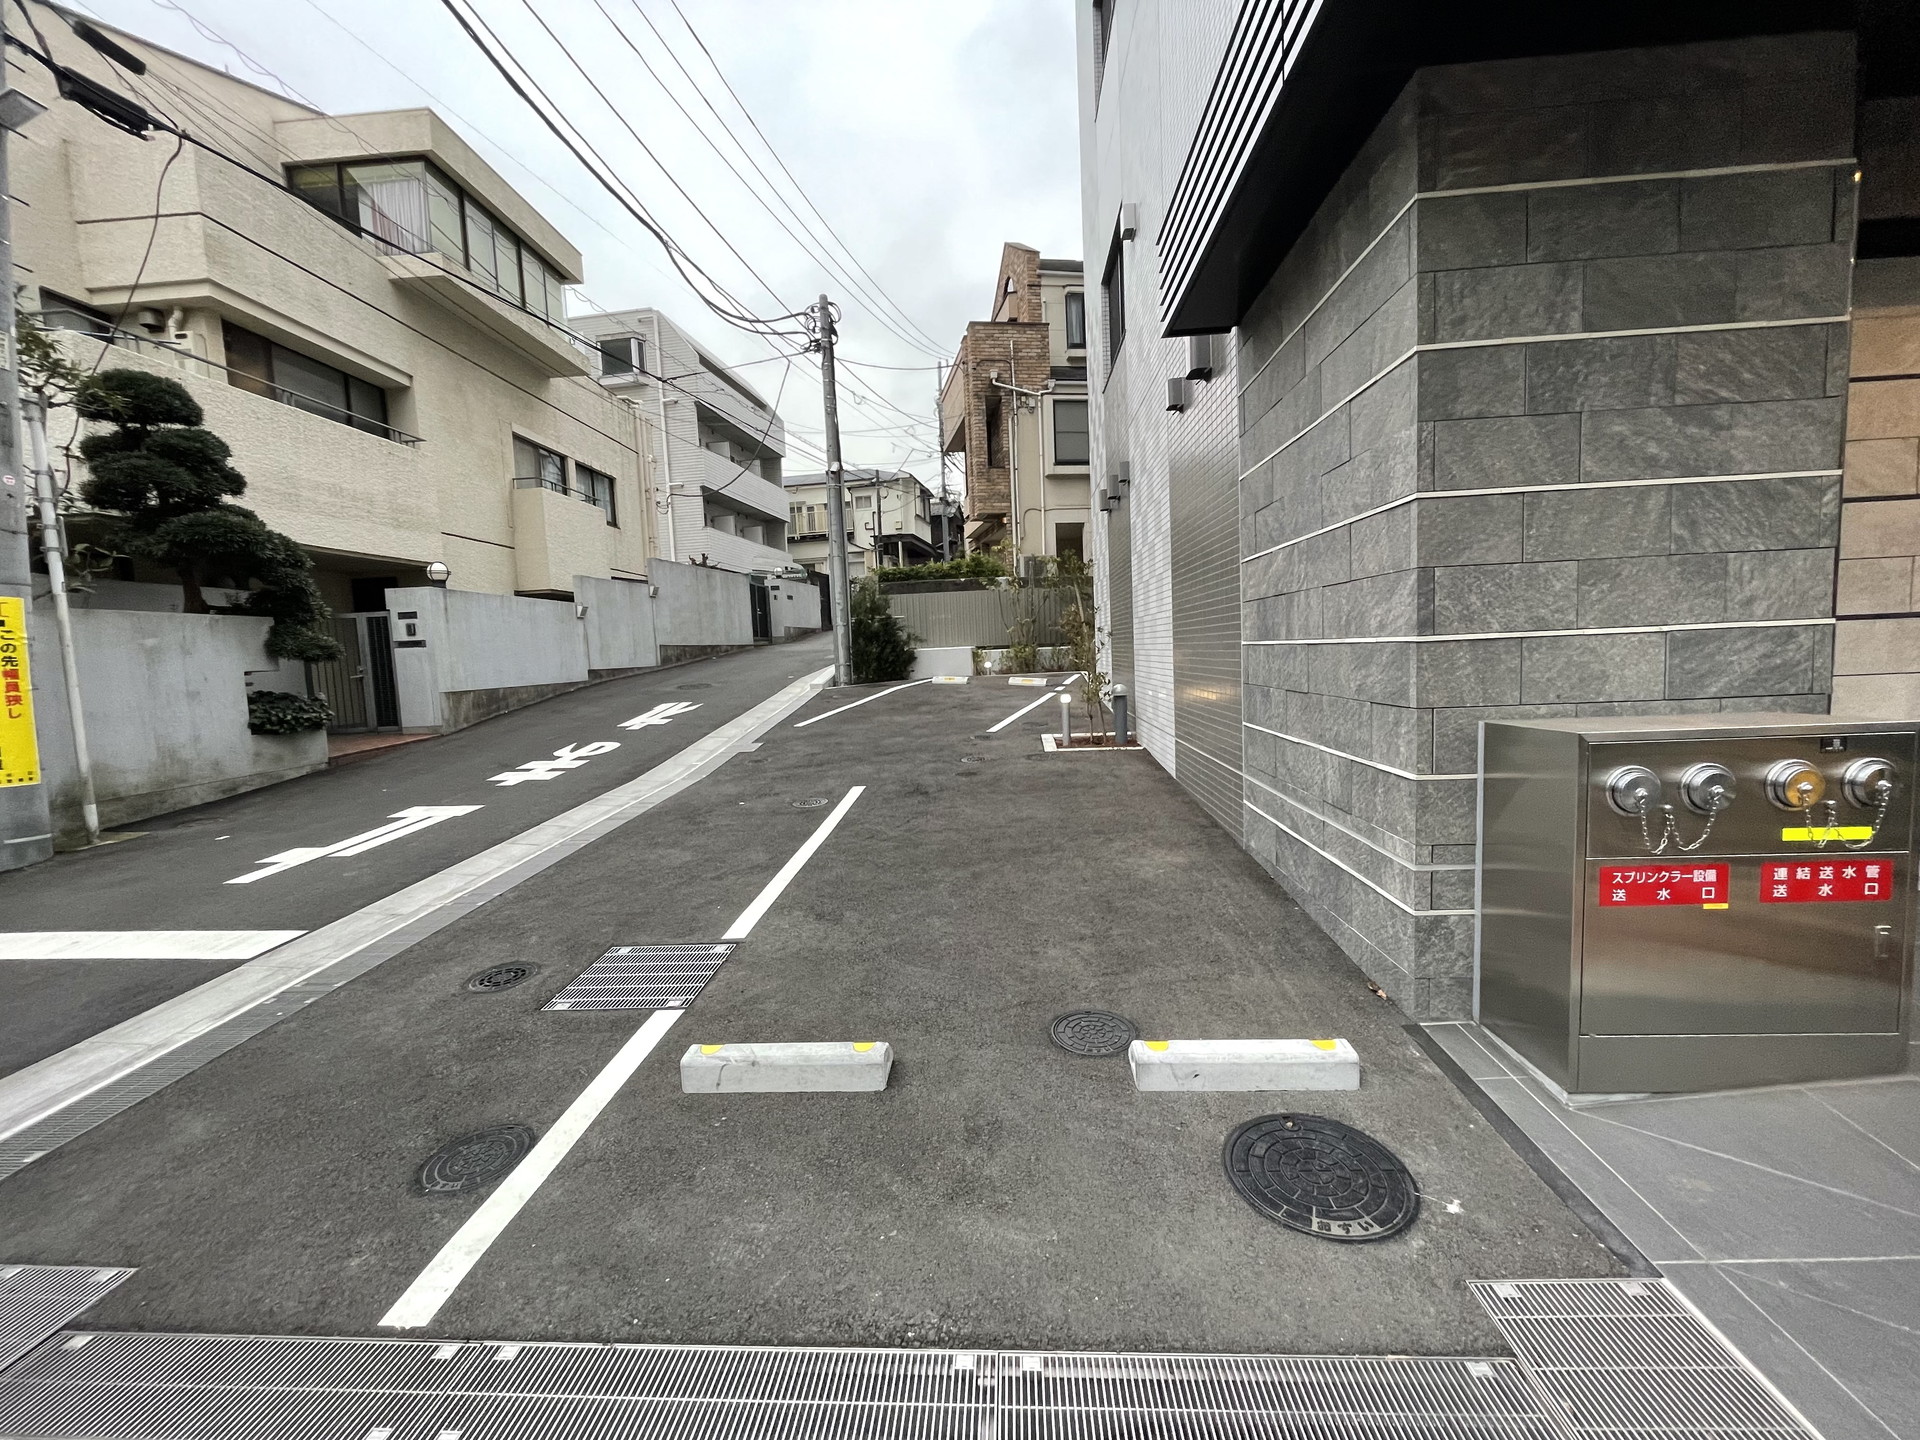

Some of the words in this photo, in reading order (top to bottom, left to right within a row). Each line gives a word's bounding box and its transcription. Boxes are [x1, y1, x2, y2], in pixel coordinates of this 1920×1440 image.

[1773, 865, 1880, 880] 連結送水管
[1612, 887, 1715, 901] 送水口
[1773, 882, 1878, 897] 送水口
